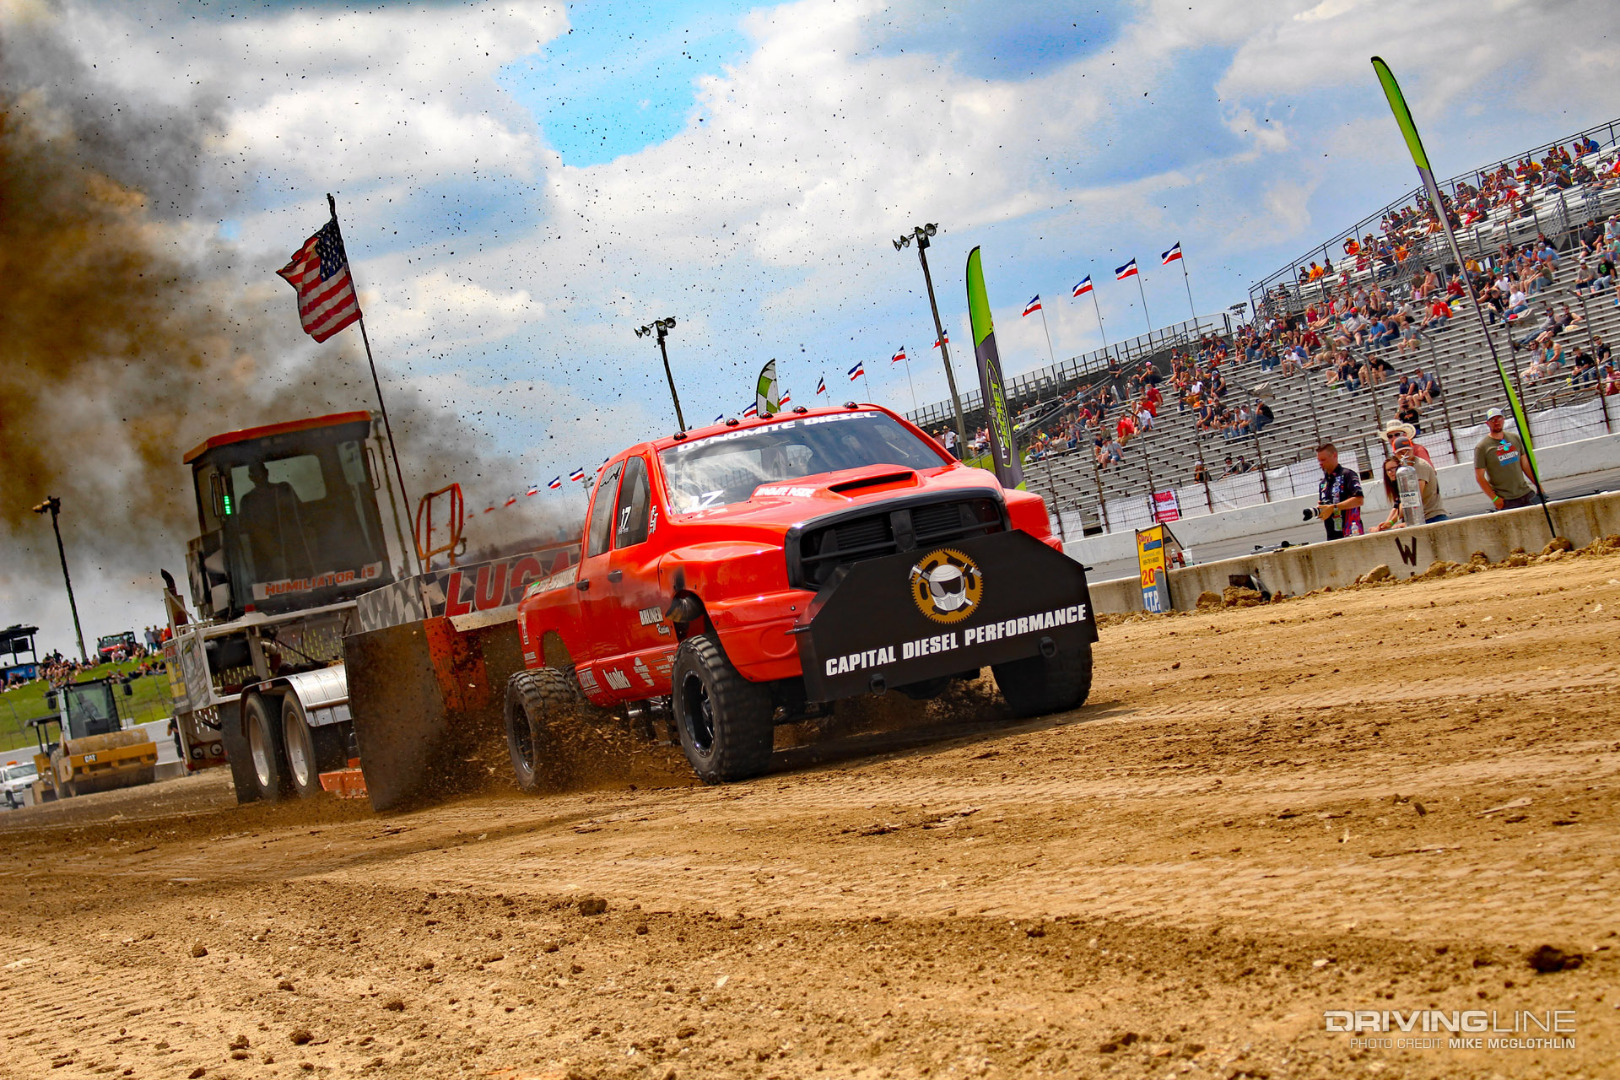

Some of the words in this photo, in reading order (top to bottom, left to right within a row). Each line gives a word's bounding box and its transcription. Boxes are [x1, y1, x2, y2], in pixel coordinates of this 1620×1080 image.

[677, 420, 796, 452] DYNOMITE
[803, 412, 878, 425] DIESEL
[620, 506, 632, 529] 17
[1394, 536, 1417, 567] W
[265, 570, 355, 596] HUMILIATOR
[1142, 566, 1164, 586] 20
[825, 645, 897, 677] CAPITAL
[902, 632, 959, 660] DIESEL
[964, 604, 1087, 647] PERFORMANCE
[84, 754, 97, 763] CAT
